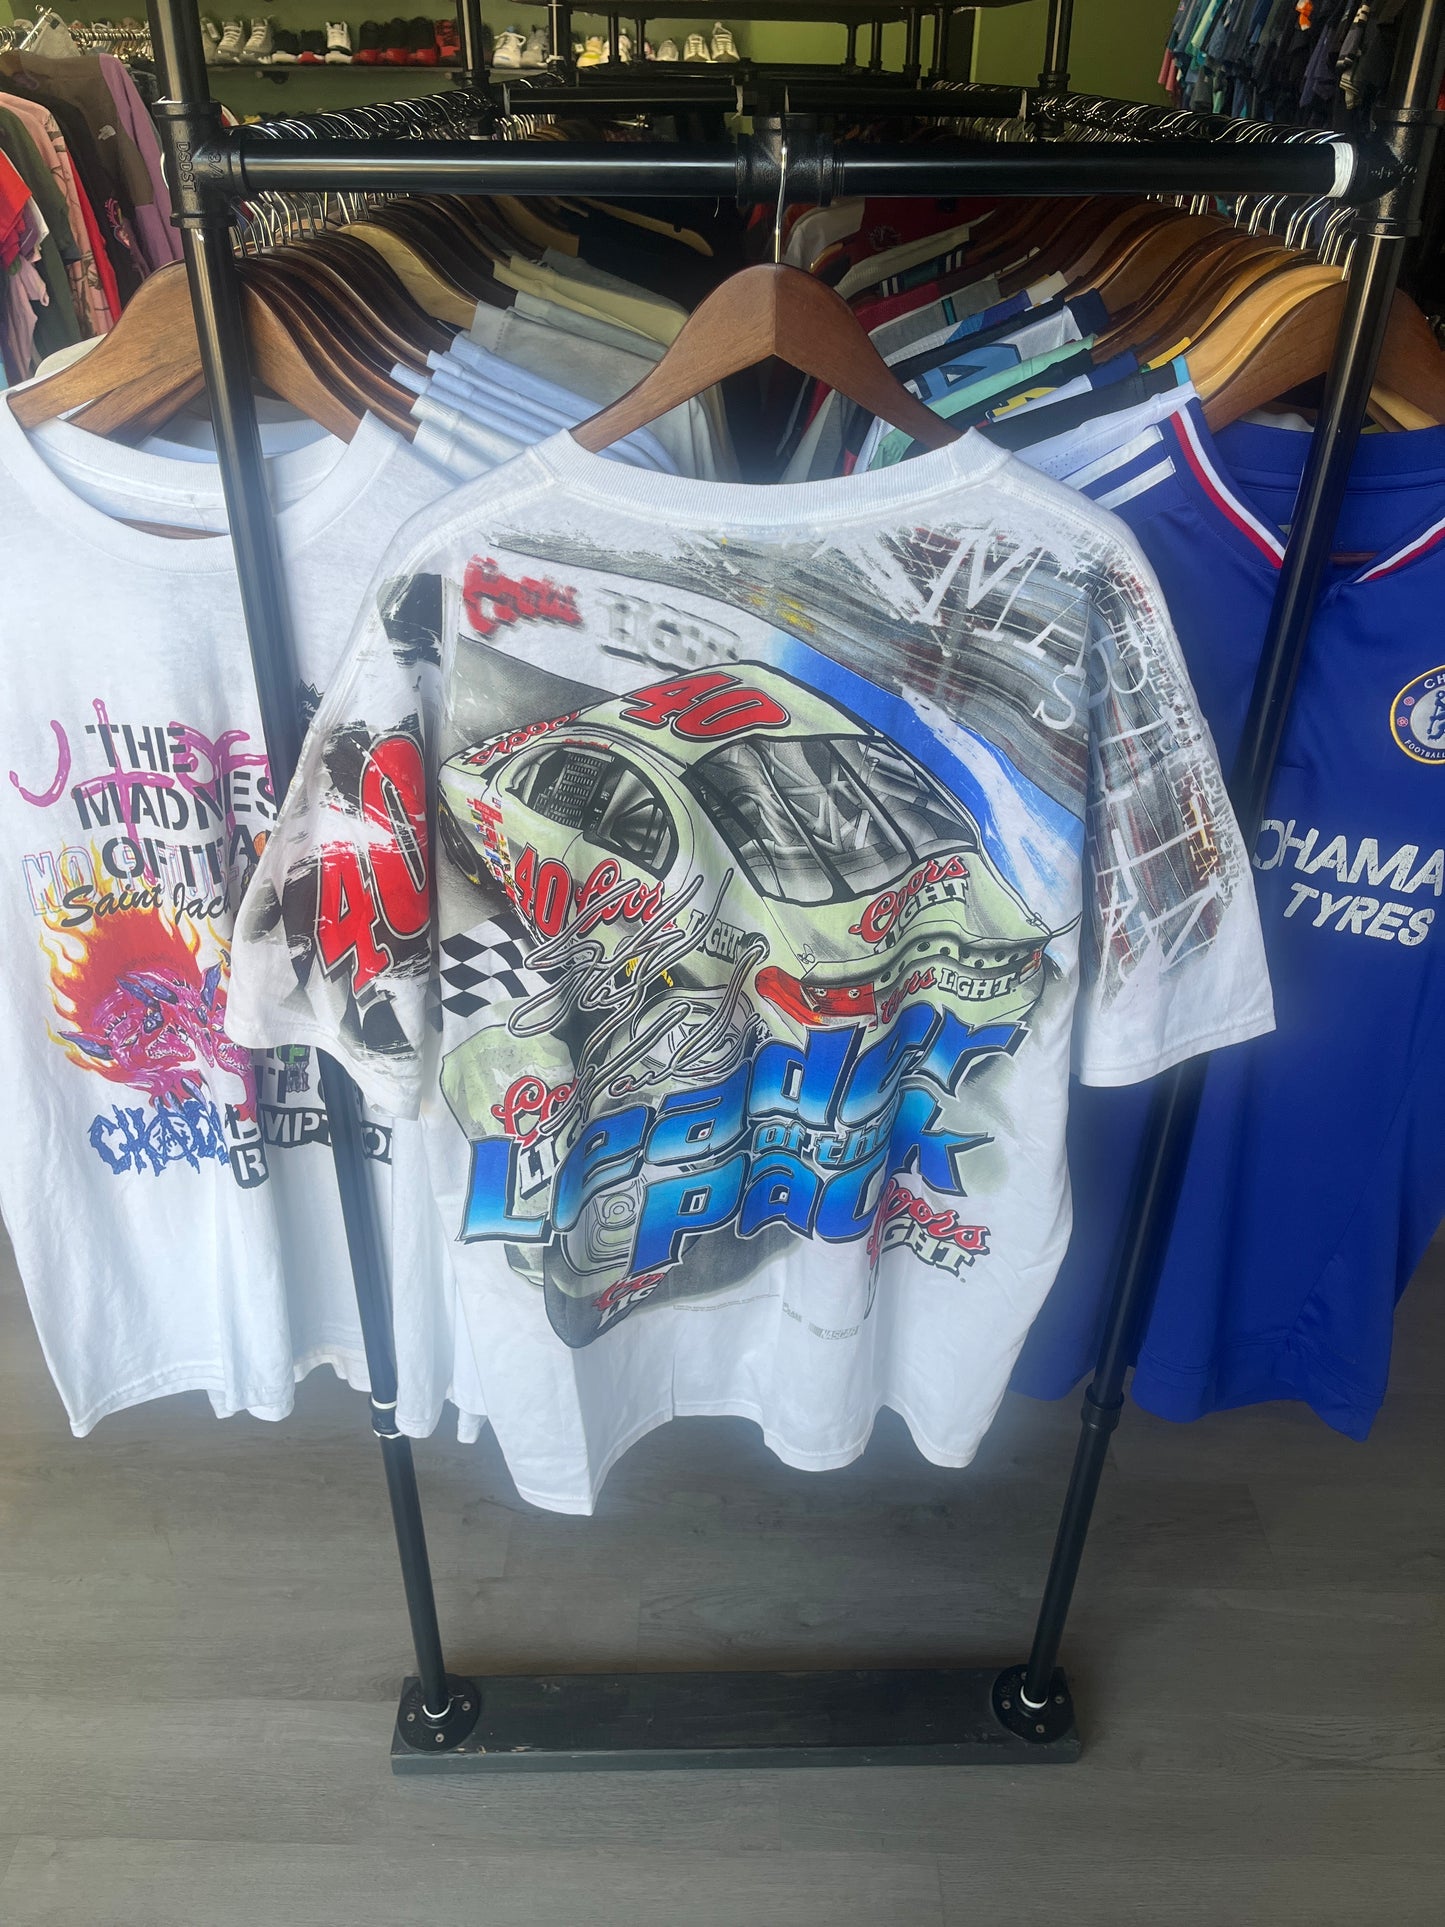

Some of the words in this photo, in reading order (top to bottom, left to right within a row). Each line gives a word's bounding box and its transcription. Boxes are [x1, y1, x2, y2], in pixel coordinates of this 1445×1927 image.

[177, 142, 197, 192] DSDST
[619, 671, 791, 743] 40
[85, 723, 192, 773] THE
[1404, 738, 1445, 758] FOOTBALL
[22, 845, 98, 916] NO
[102, 836, 168, 879] OF
[315, 731, 431, 1000] 40
[61, 883, 163, 928] Saint
[514, 842, 573, 938] 40
[848, 854, 970, 944] Coors
[1283, 882, 1435, 946] TYRES
[685, 908, 746, 963] LGHT
[938, 968, 1017, 1001] LIGHT
[454, 1001, 1032, 1247] Leader
[752, 1119, 808, 1155] of
[881, 1215, 977, 1278] GHT
